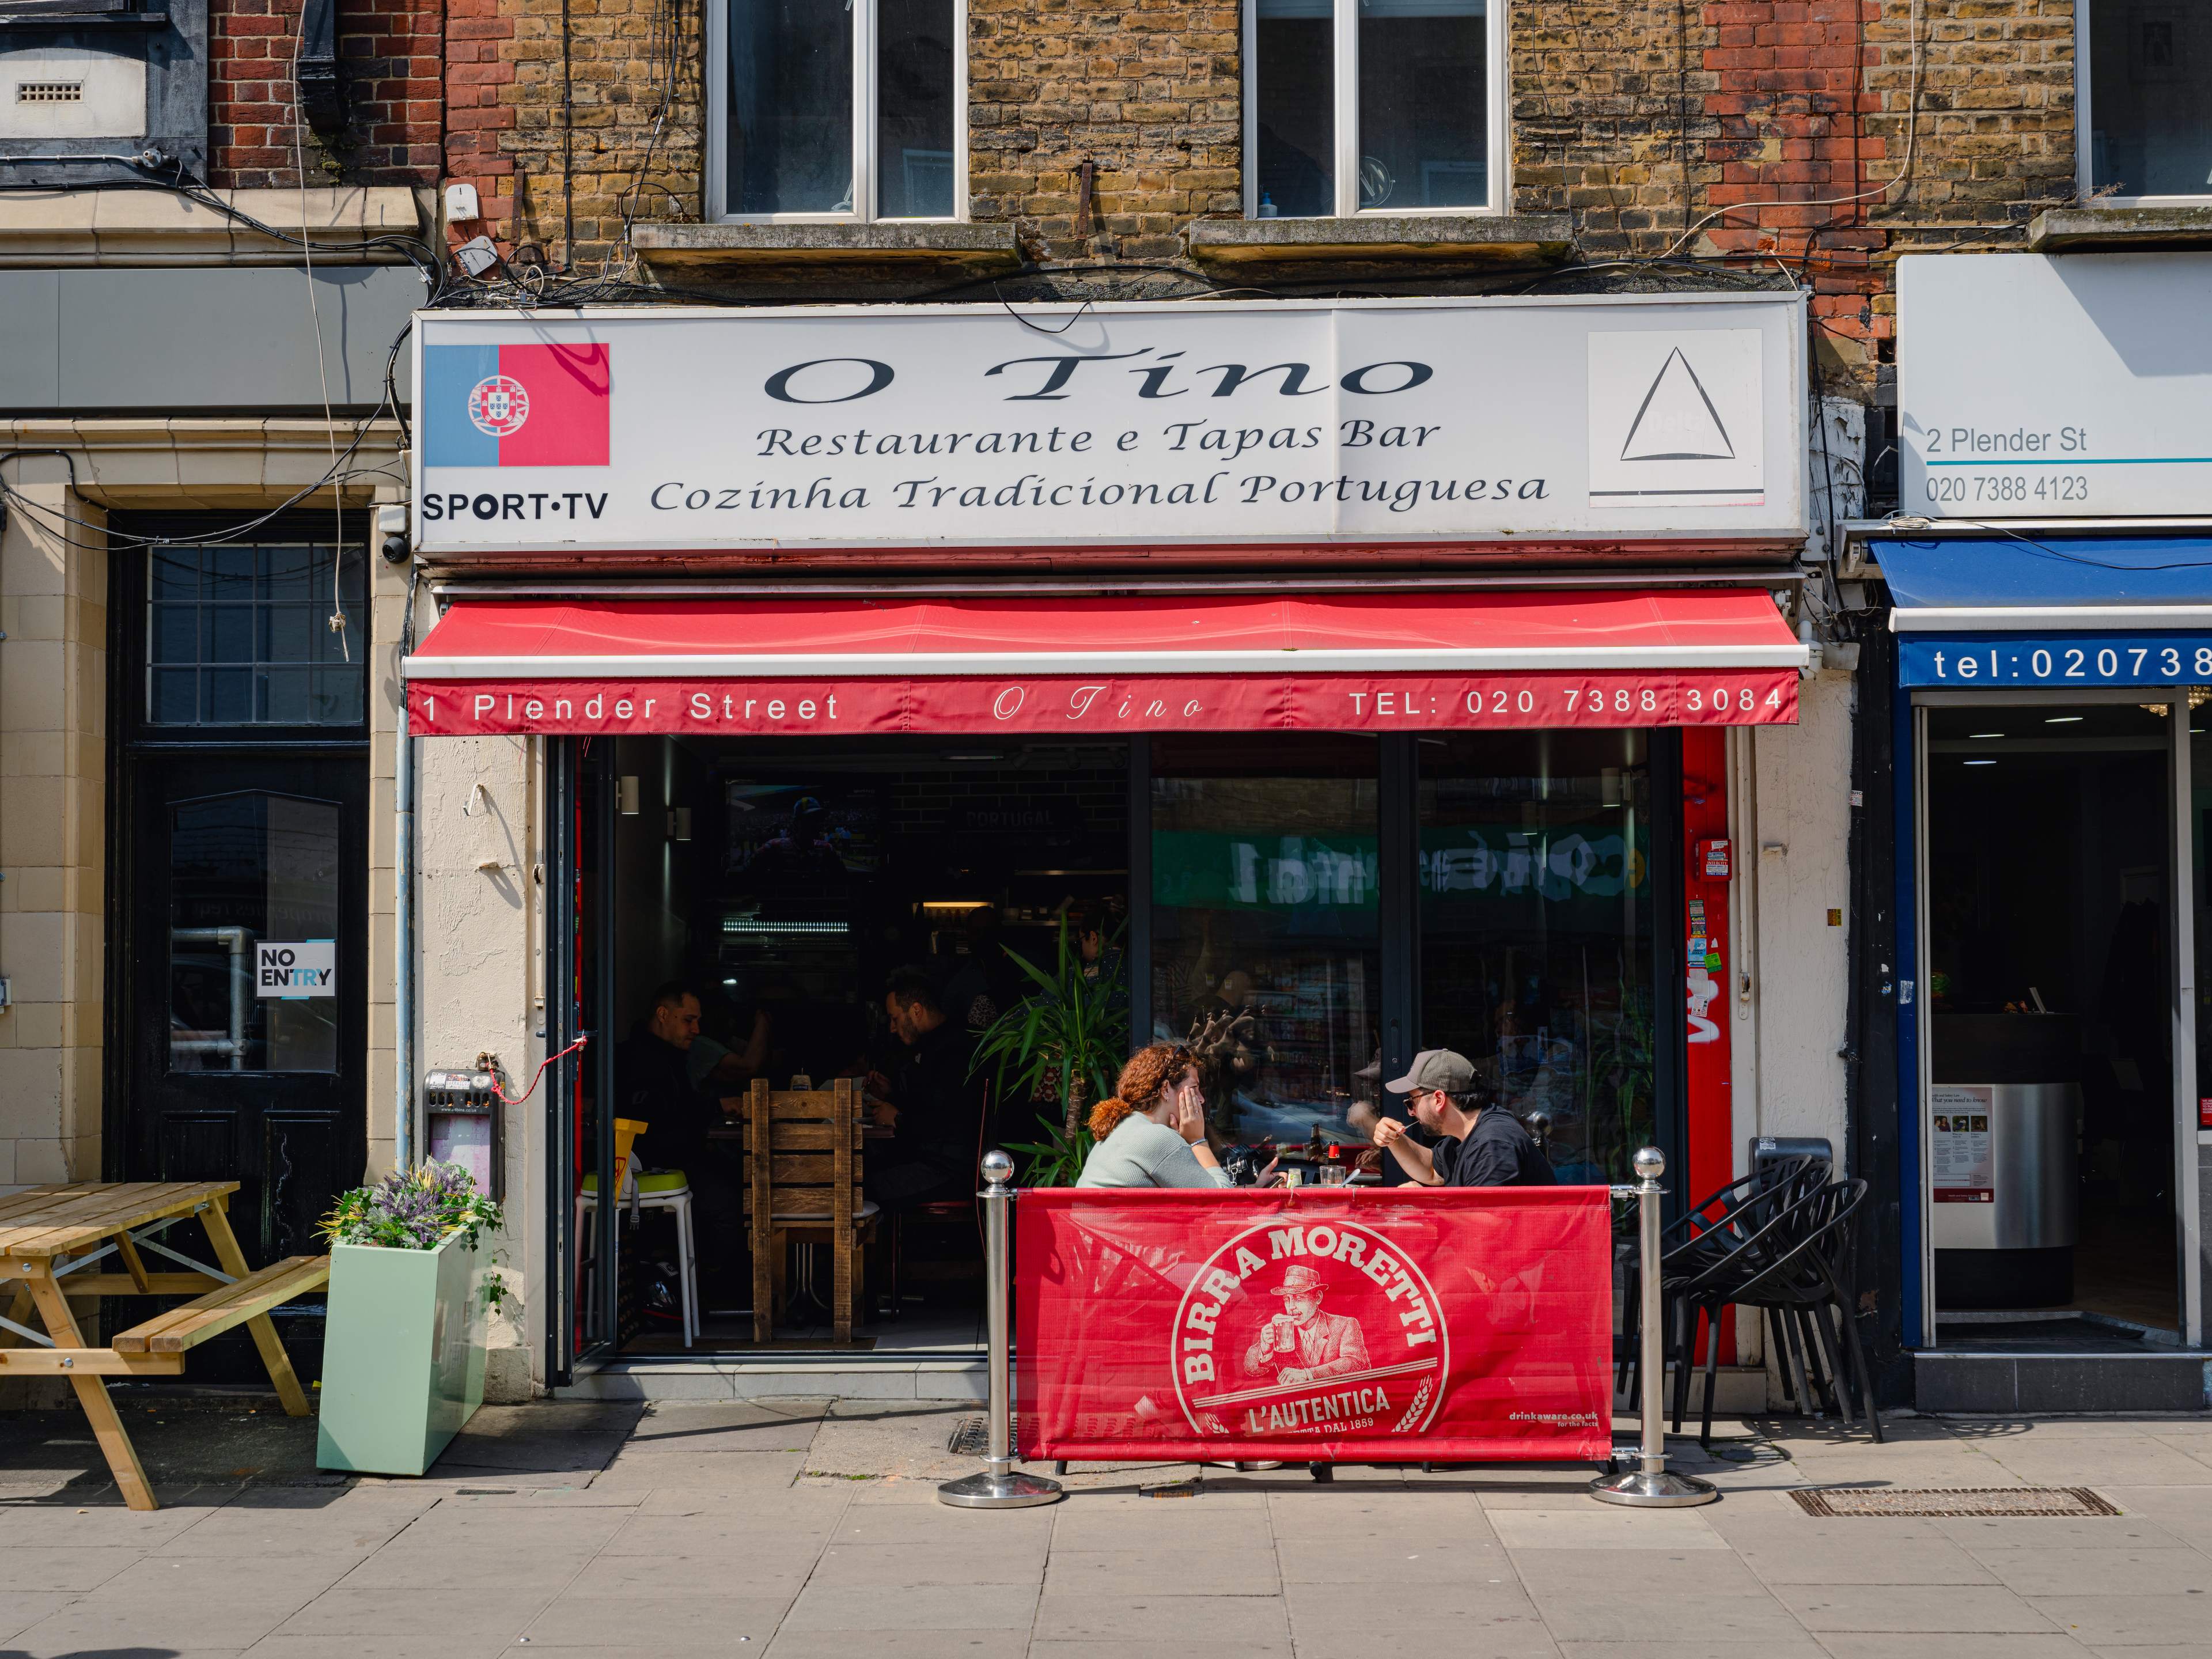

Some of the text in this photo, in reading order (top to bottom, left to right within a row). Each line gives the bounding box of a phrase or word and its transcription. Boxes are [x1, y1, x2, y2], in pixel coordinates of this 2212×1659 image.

[764, 347, 1433, 403] O Tino
[757, 419, 1441, 460] Restaurante e Tapas Bar
[1927, 427, 2086, 452] 2 Plender St
[652, 472, 1549, 512] Cozinha Tradicional Portuguesa
[1926, 476, 2088, 501] 020 7388 4123
[423, 693, 838, 721] 1 Plender Street
[993, 686, 1203, 719] O Tino
[1350, 688, 1781, 714] TEL: 020 7388 3084
[966, 809, 1054, 828] PORTUGAL
[261, 949, 295, 967] NO
[261, 968, 332, 986] ENTRY
[1184, 1226, 1437, 1385] BIRRA MORETTI
[1324, 1422, 1347, 1433] DAL
[1350, 1418, 1374, 1430] 1859
[1509, 1411, 1598, 1420] drinkaware.co.uk
